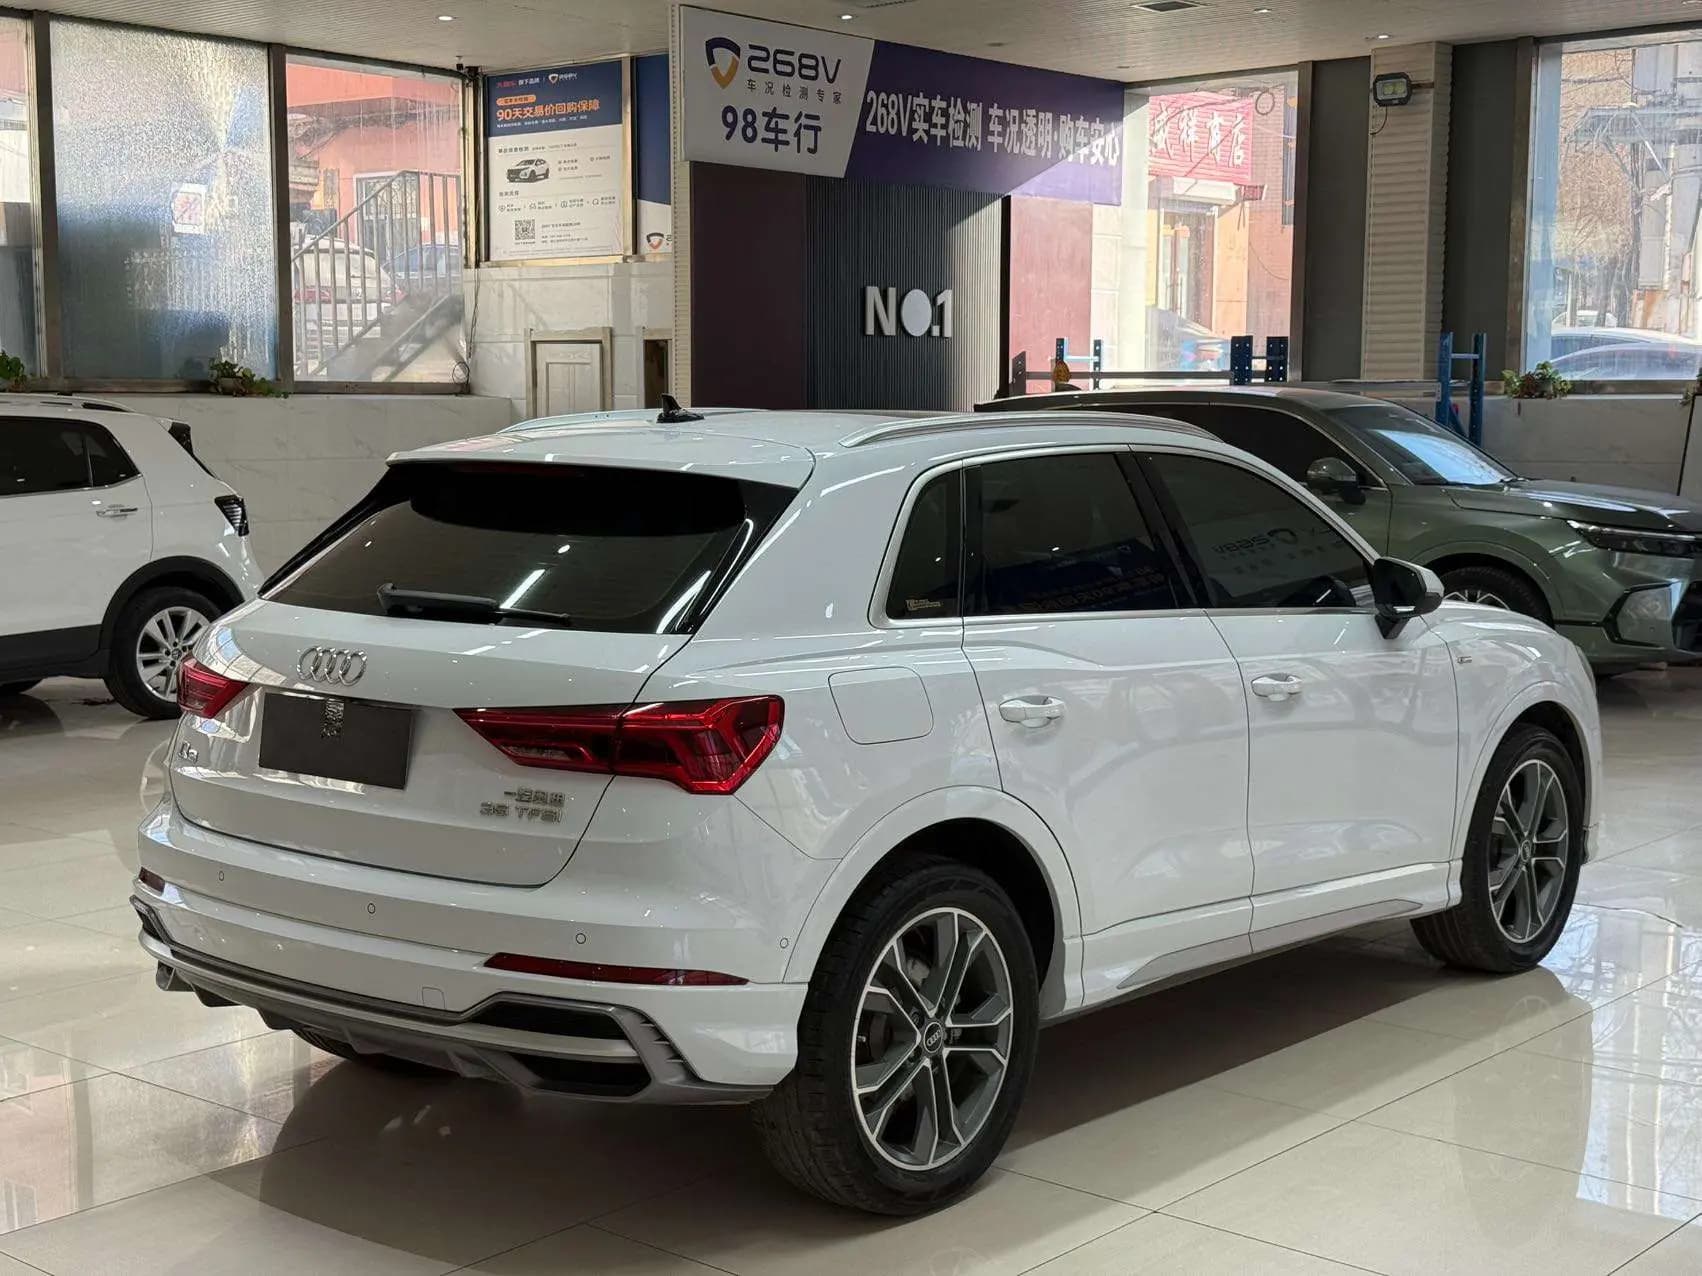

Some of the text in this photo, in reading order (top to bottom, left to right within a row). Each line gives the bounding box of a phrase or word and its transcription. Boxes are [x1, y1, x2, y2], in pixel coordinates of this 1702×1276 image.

[747, 43, 842, 84] 268V
[496, 98, 600, 121] 90天交易价回购保障
[747, 78, 842, 104] 车况检测专家
[721, 105, 823, 155] 98车行
[865, 90, 983, 152] 268V实车检测
